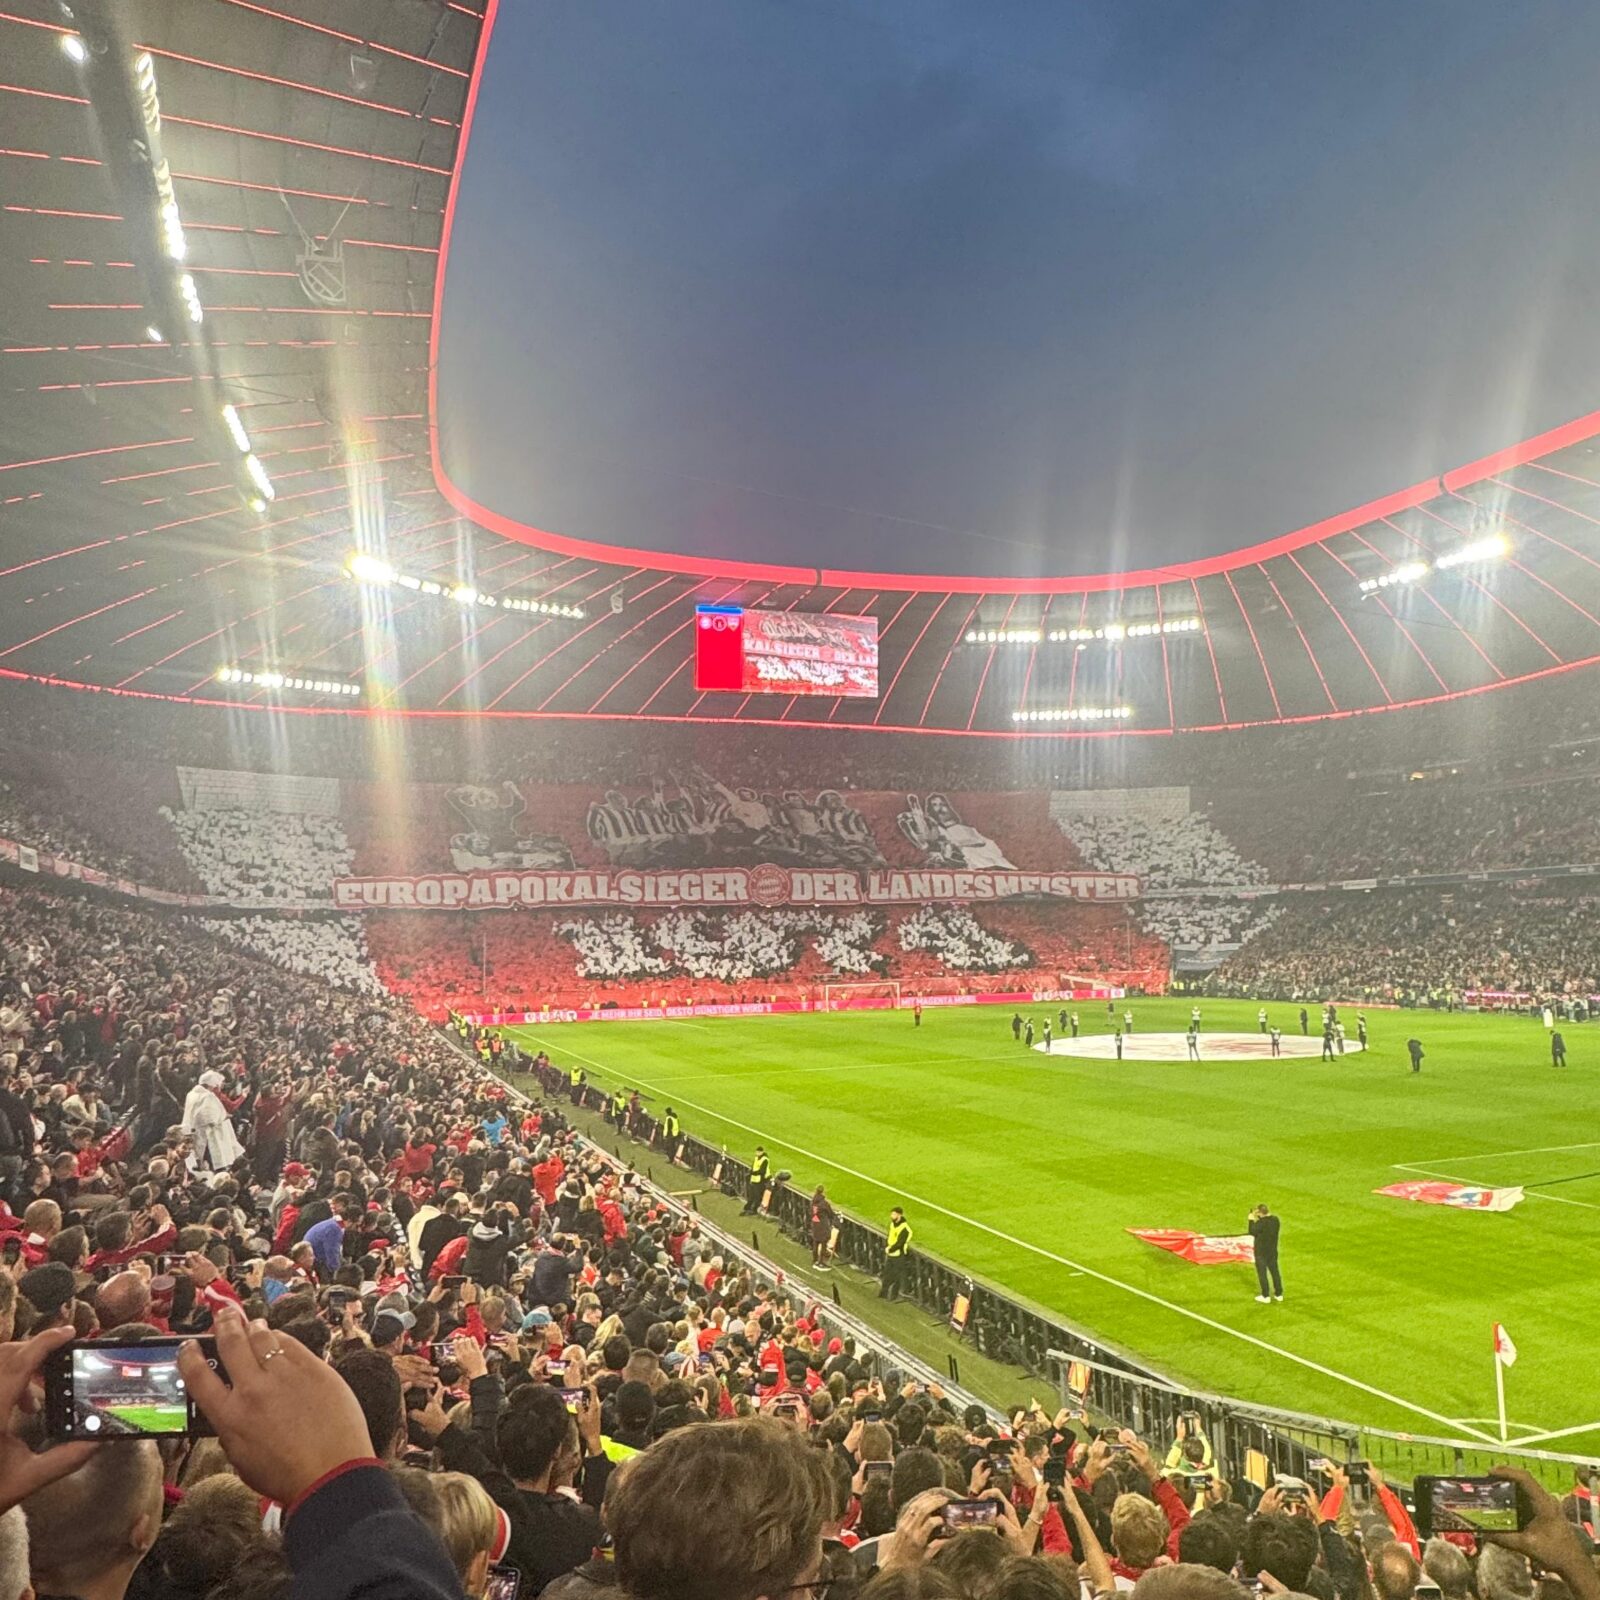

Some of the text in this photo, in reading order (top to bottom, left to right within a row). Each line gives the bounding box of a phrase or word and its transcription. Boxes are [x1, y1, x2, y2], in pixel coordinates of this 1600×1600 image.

[336, 872, 748, 905] EUROPAPOKALSIEGER
[791, 872, 859, 901] DER
[868, 873, 1140, 899] LANDESMEISTER
[916, 996, 953, 1007] MAGENTA
[666, 1005, 693, 1016] DESTO
